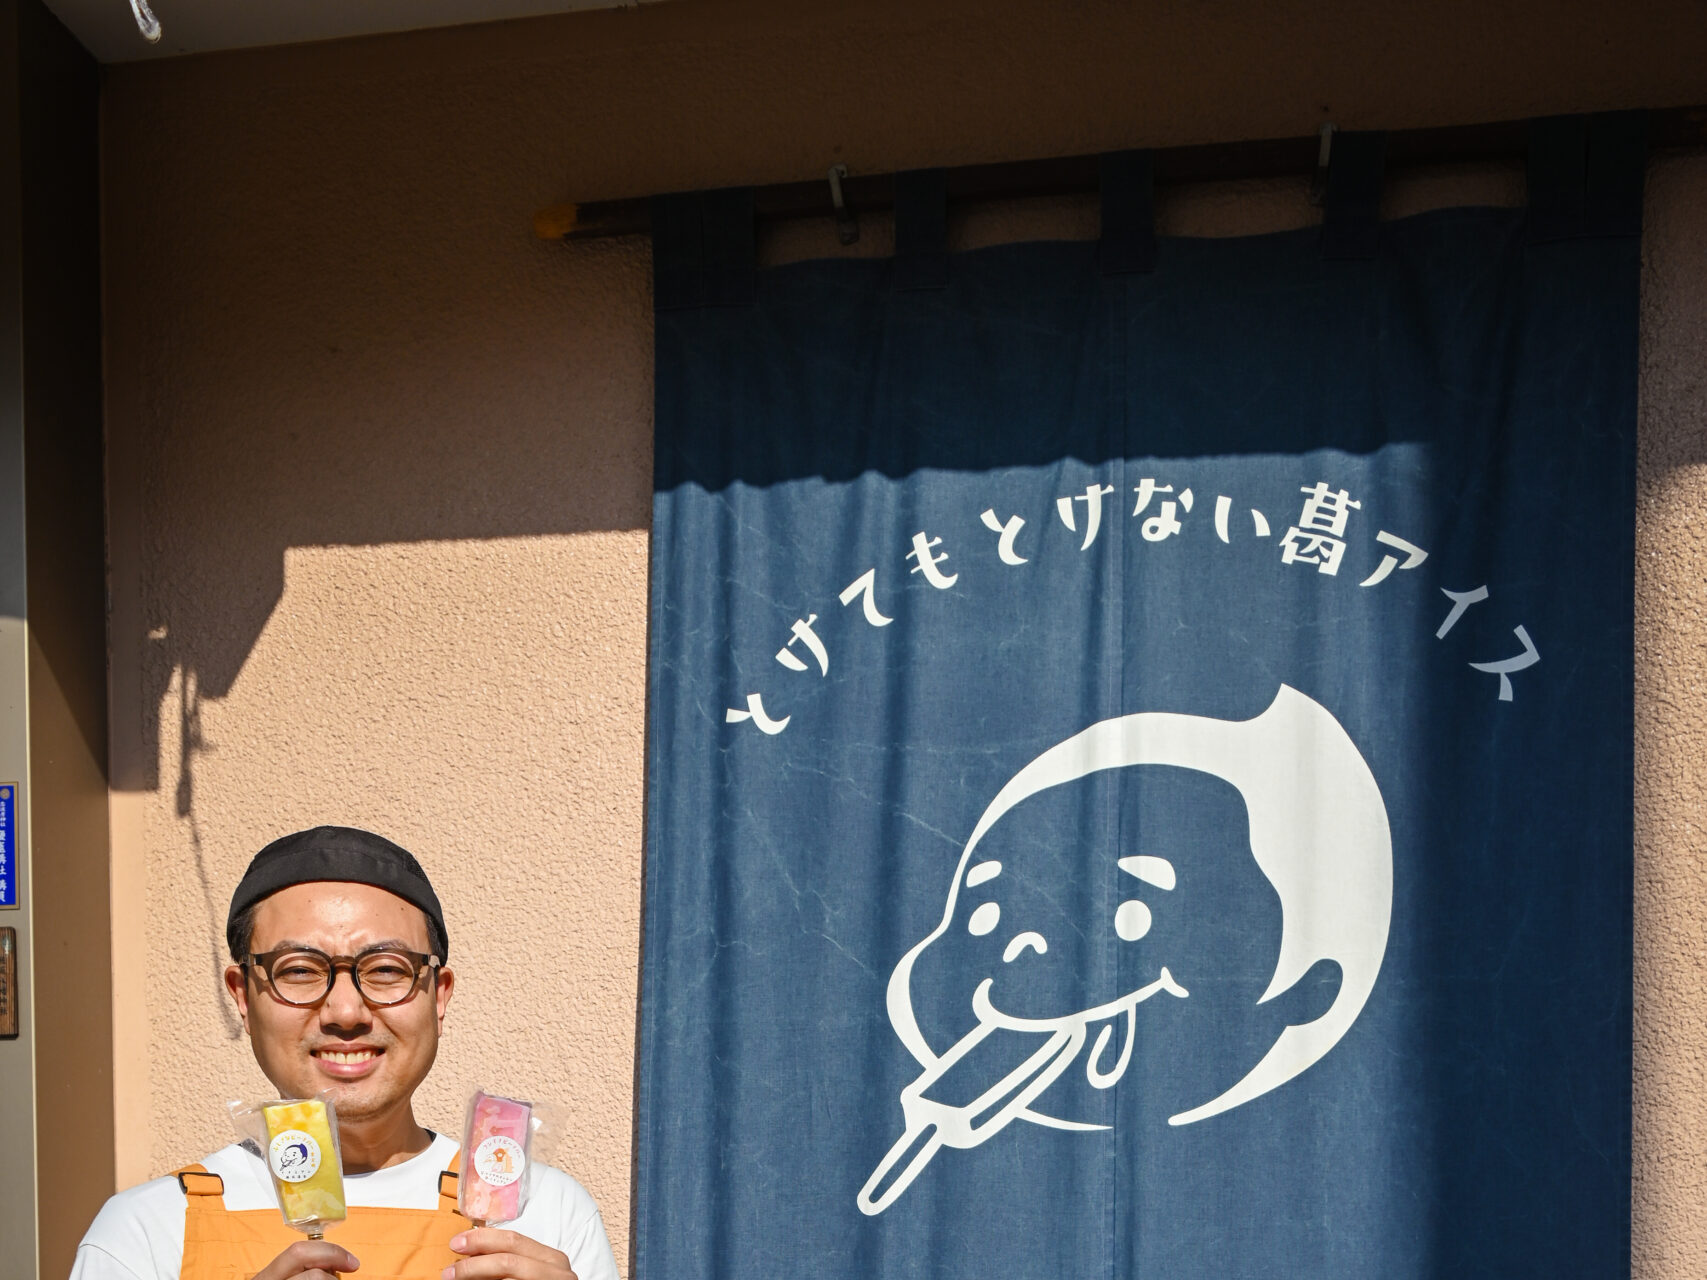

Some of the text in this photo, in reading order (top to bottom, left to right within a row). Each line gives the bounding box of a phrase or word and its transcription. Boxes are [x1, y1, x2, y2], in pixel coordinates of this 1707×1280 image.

[726, 478, 1540, 736] とけてもとけない葛アイス
